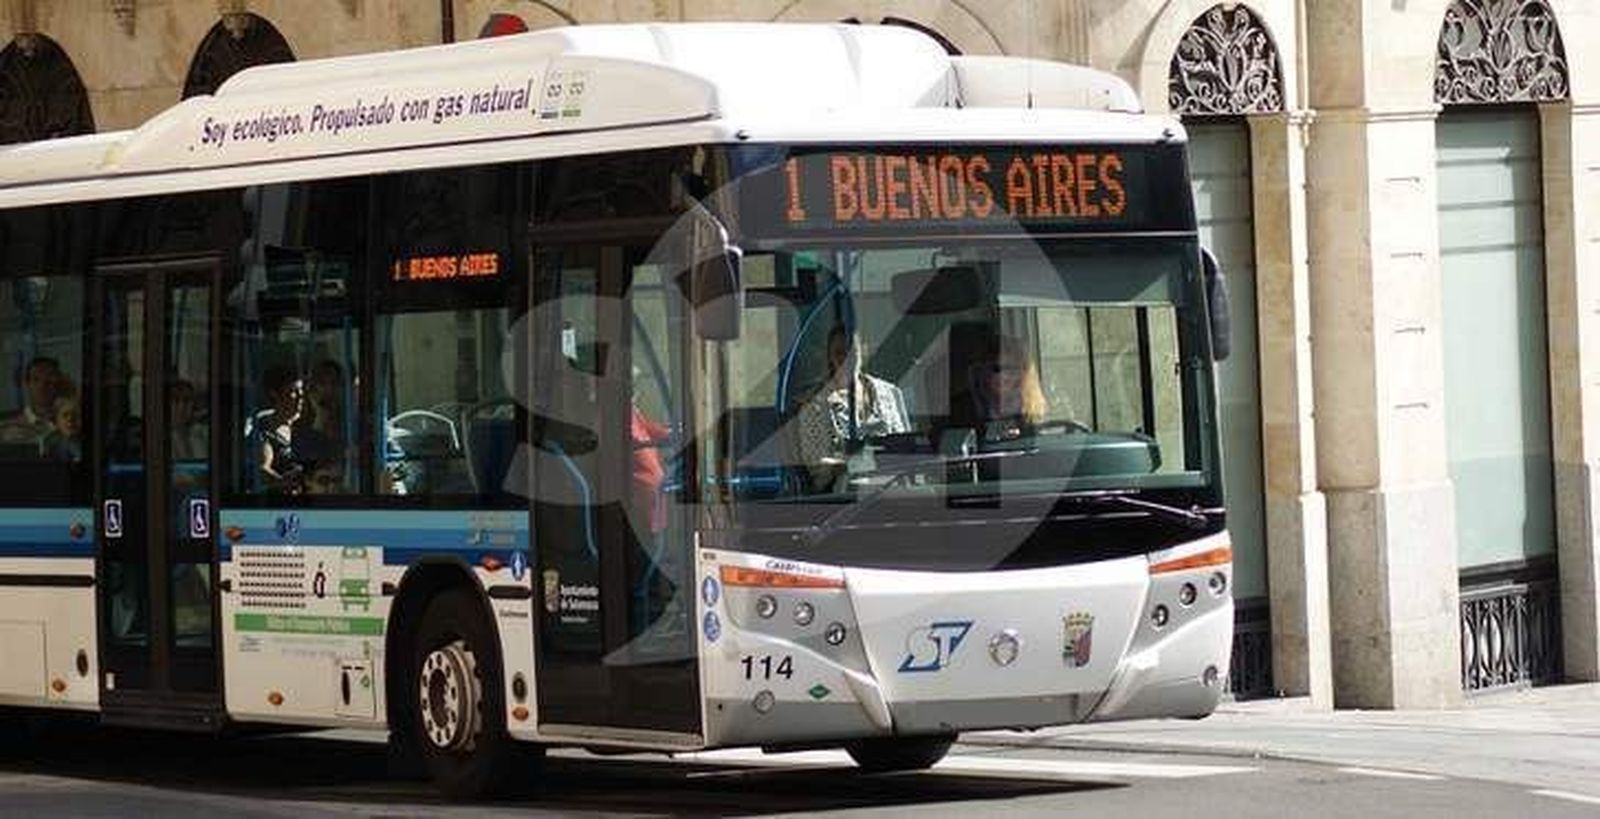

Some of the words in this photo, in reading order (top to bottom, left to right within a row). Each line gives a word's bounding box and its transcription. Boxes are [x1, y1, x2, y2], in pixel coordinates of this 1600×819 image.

[202, 117, 227, 147] Soy
[310, 97, 395, 134] Propulsado
[400, 99, 429, 121] con
[433, 94, 463, 124] gas
[469, 79, 533, 113] natural
[784, 158, 805, 221] 1
[832, 155, 994, 221] BUENOS
[1006, 154, 1126, 218] AIRES
[410, 257, 457, 279] BUENOS
[460, 254, 498, 276] AIRES
[740, 655, 794, 680] 114
